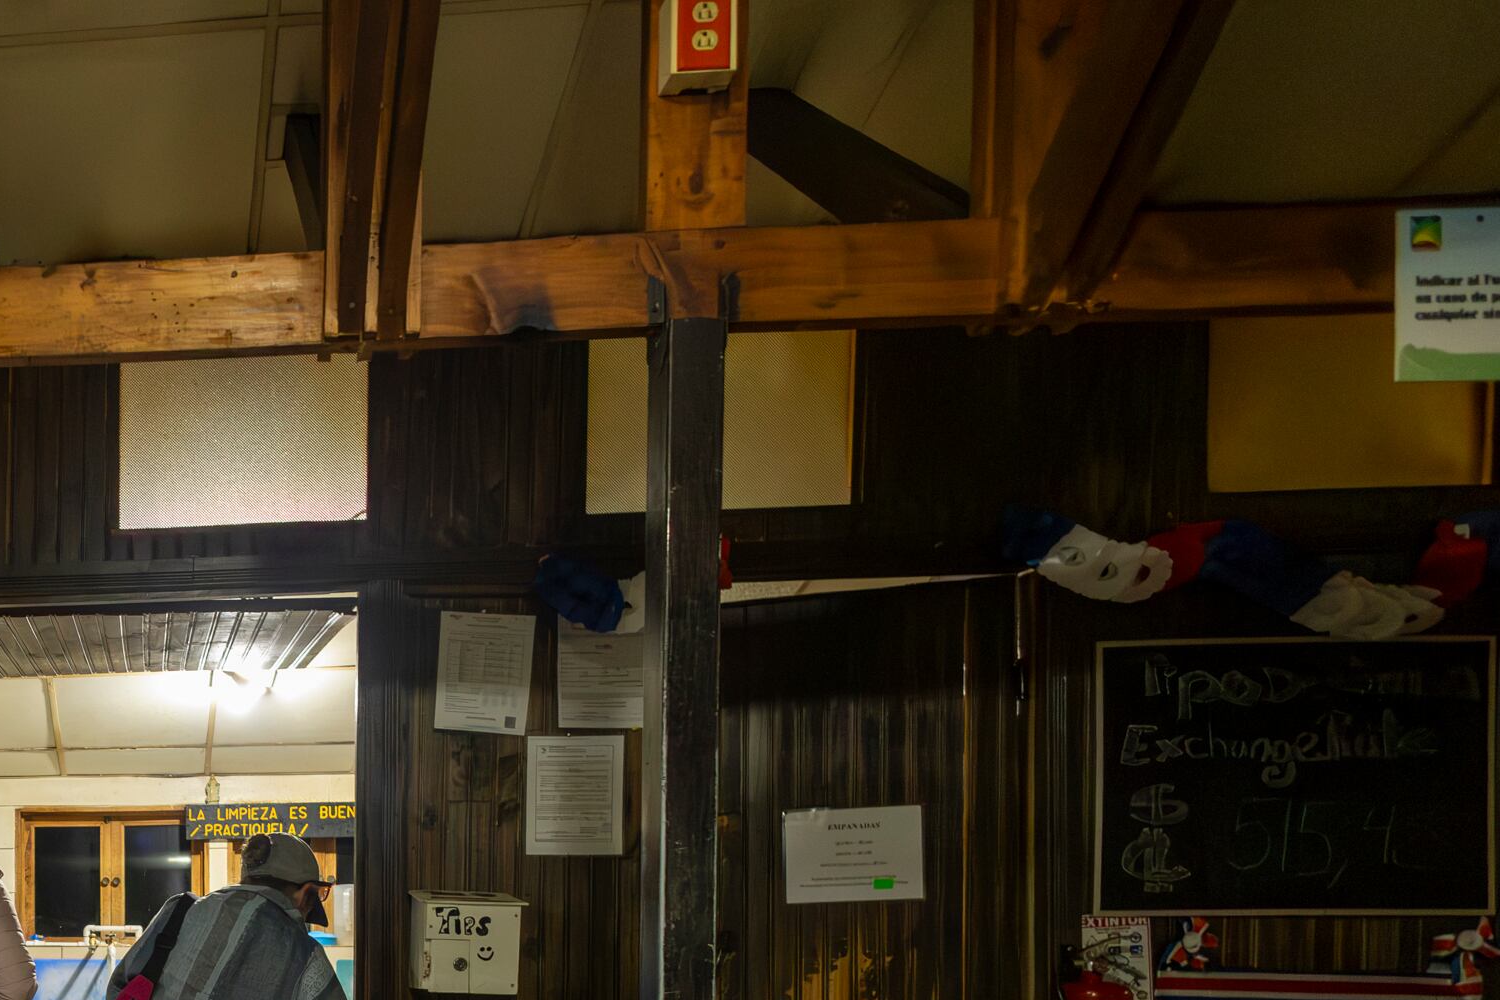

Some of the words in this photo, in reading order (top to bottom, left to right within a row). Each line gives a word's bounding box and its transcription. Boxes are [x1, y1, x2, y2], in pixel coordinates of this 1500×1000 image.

[188, 807, 206, 822] LA
[289, 805, 308, 820] ES
[1081, 916, 1147, 928] EXTINTOR
